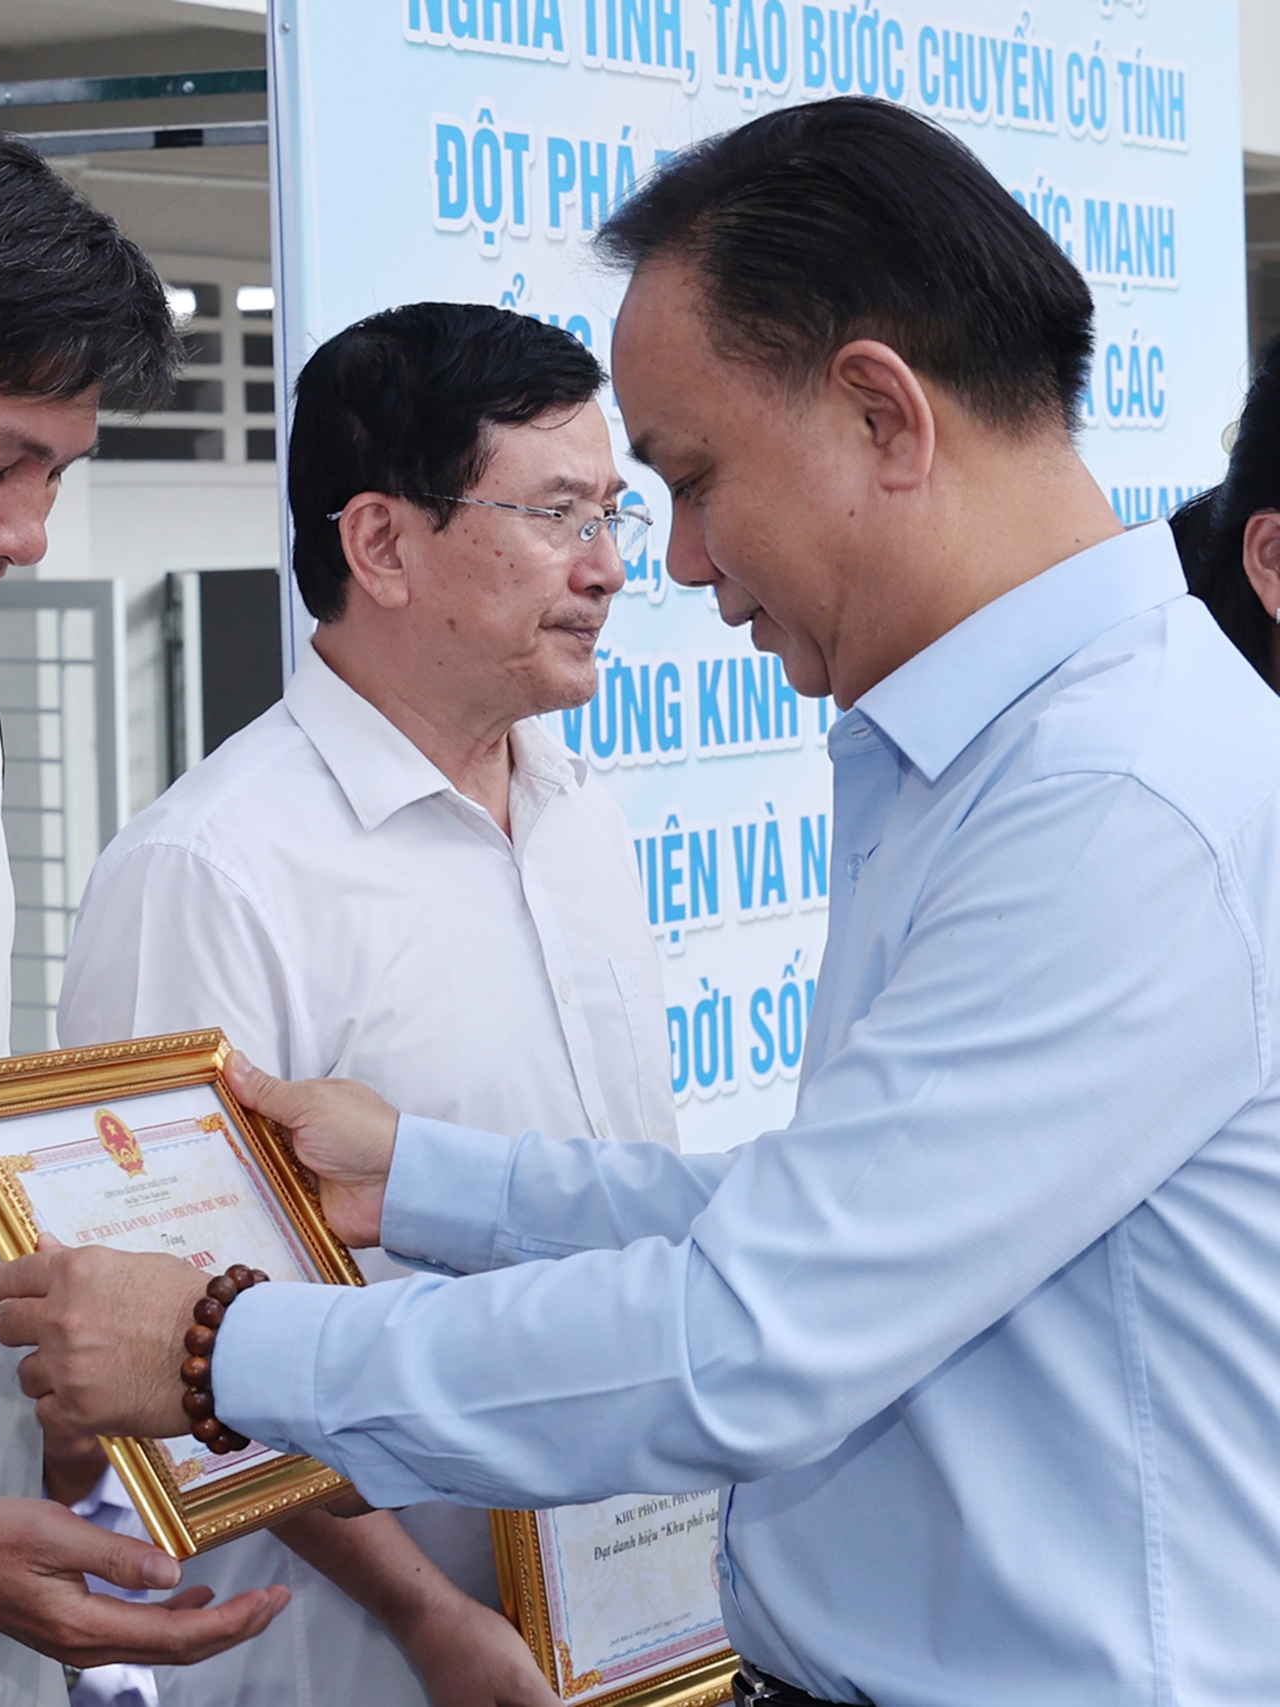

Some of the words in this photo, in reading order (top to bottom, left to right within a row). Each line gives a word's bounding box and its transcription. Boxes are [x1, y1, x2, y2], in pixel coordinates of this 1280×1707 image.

[709, 0, 787, 99] TẠO
[803, 0, 904, 100] BƯỚC
[919, 11, 1055, 124] CHUYỂN
[1066, 40, 1107, 131] CÓ
[1117, 48, 1186, 142] TÍNH
[435, 107, 529, 246] ĐỘT
[547, 125, 637, 230] PHÁ
[1084, 199, 1176, 293] MẠNH
[1105, 328, 1165, 418] CÁC
[697, 656, 798, 747] KINH
[634, 814, 719, 944] IỆN
[733, 801, 787, 910] VÀ
[666, 977, 734, 1093] ĐỜI
[594, 1545, 611, 1561] Đạt
[612, 1535, 636, 1554] danh
[638, 1529, 658, 1546] hiệu
[686, 1508, 704, 1534] phố
[615, 1508, 637, 1525] KHU
